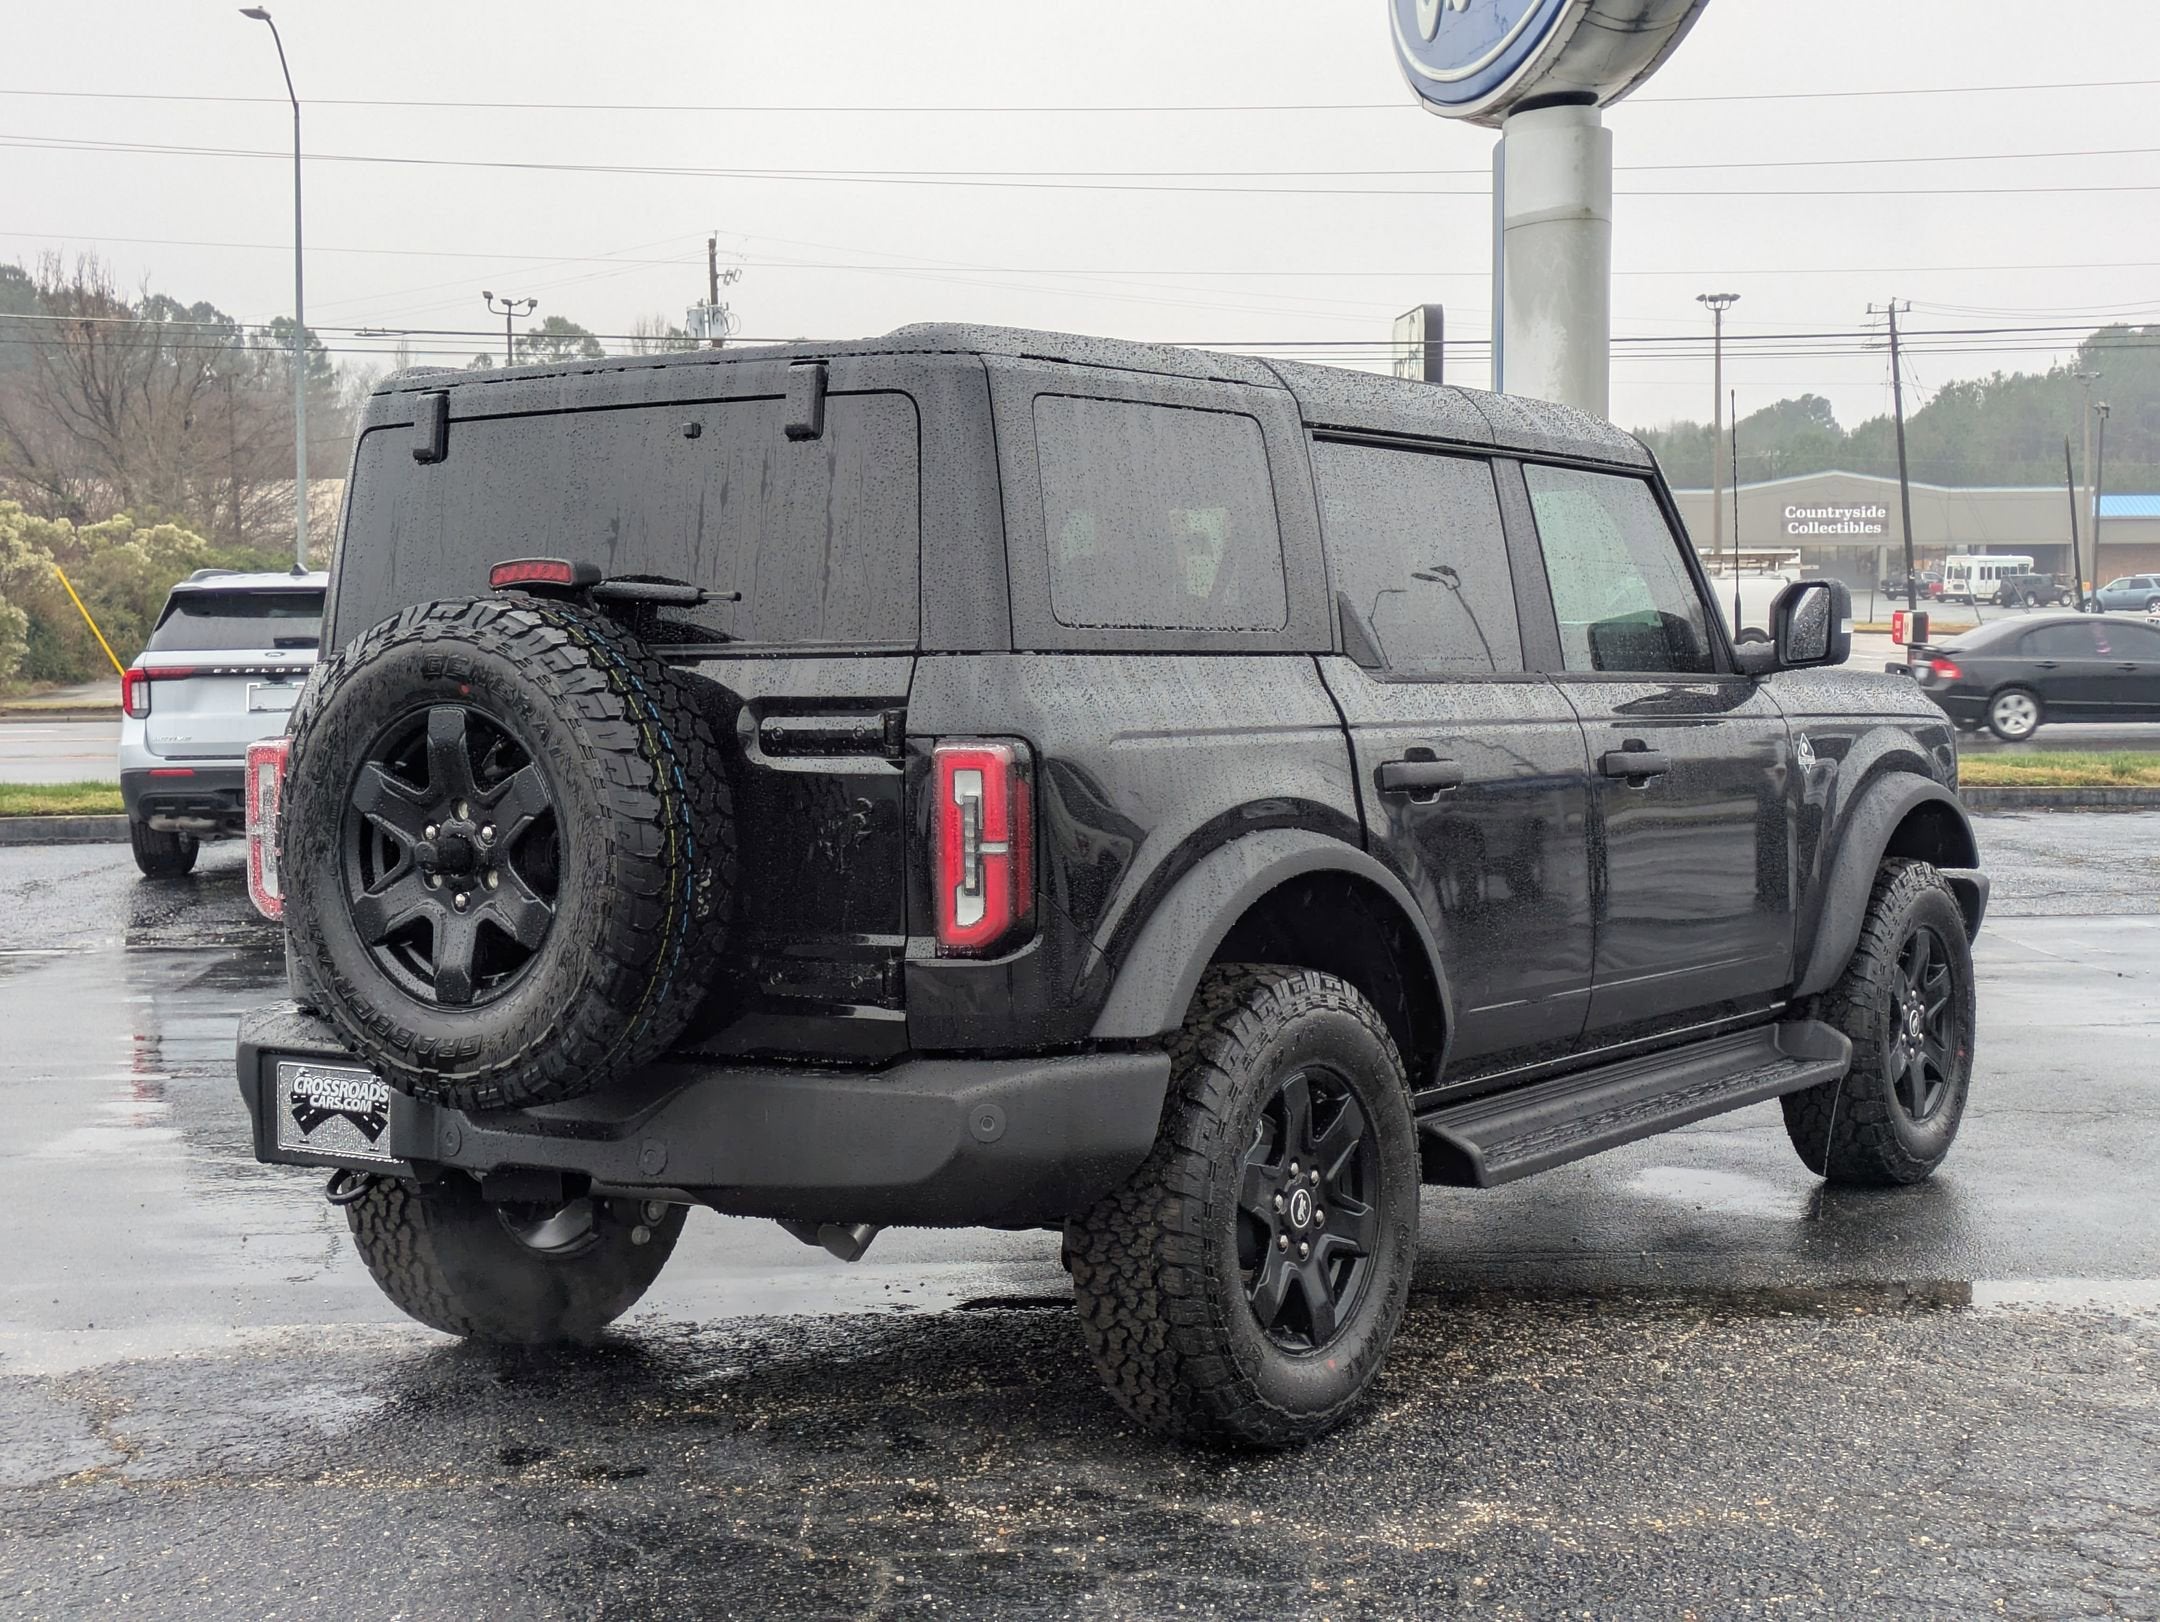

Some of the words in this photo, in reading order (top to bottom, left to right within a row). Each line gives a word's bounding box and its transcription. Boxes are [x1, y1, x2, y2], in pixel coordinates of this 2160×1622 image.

[1785, 506, 1886, 521] Countryside
[1788, 522, 1882, 534] Collectibles
[335, 974, 483, 1058] GRABBER
[293, 1076, 390, 1103] CROSSROADS
[309, 1094, 373, 1113] CARS.COM
